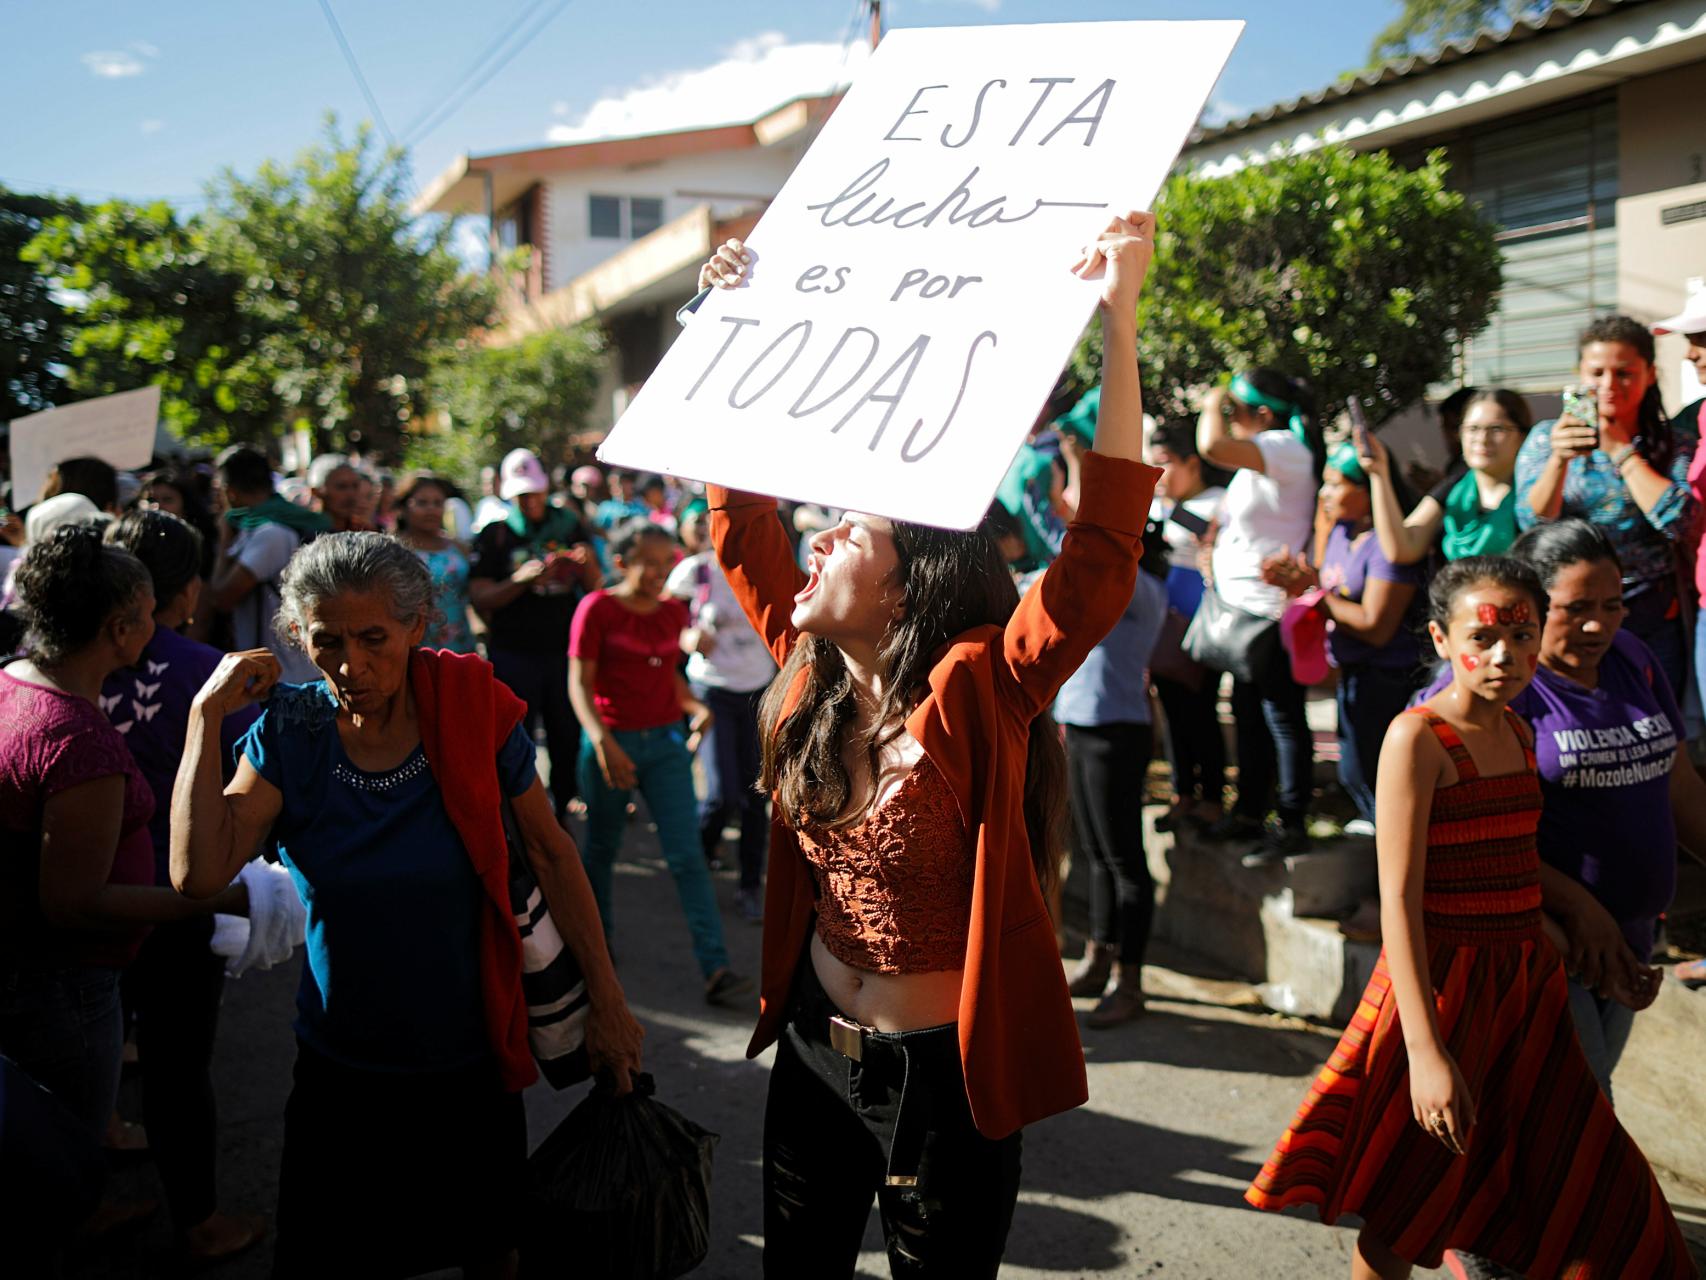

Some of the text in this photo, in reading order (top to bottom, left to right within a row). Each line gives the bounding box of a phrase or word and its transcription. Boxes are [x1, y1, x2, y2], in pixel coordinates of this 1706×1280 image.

[883, 77, 1118, 149] ESTA
[807, 157, 1110, 229] lucha
[795, 264, 850, 295] es
[684, 315, 999, 463] TODAS
[1553, 726, 1637, 752] VIOLENCIA
[1559, 753, 1577, 768] UN
[1580, 750, 1617, 765] CRIMEN
